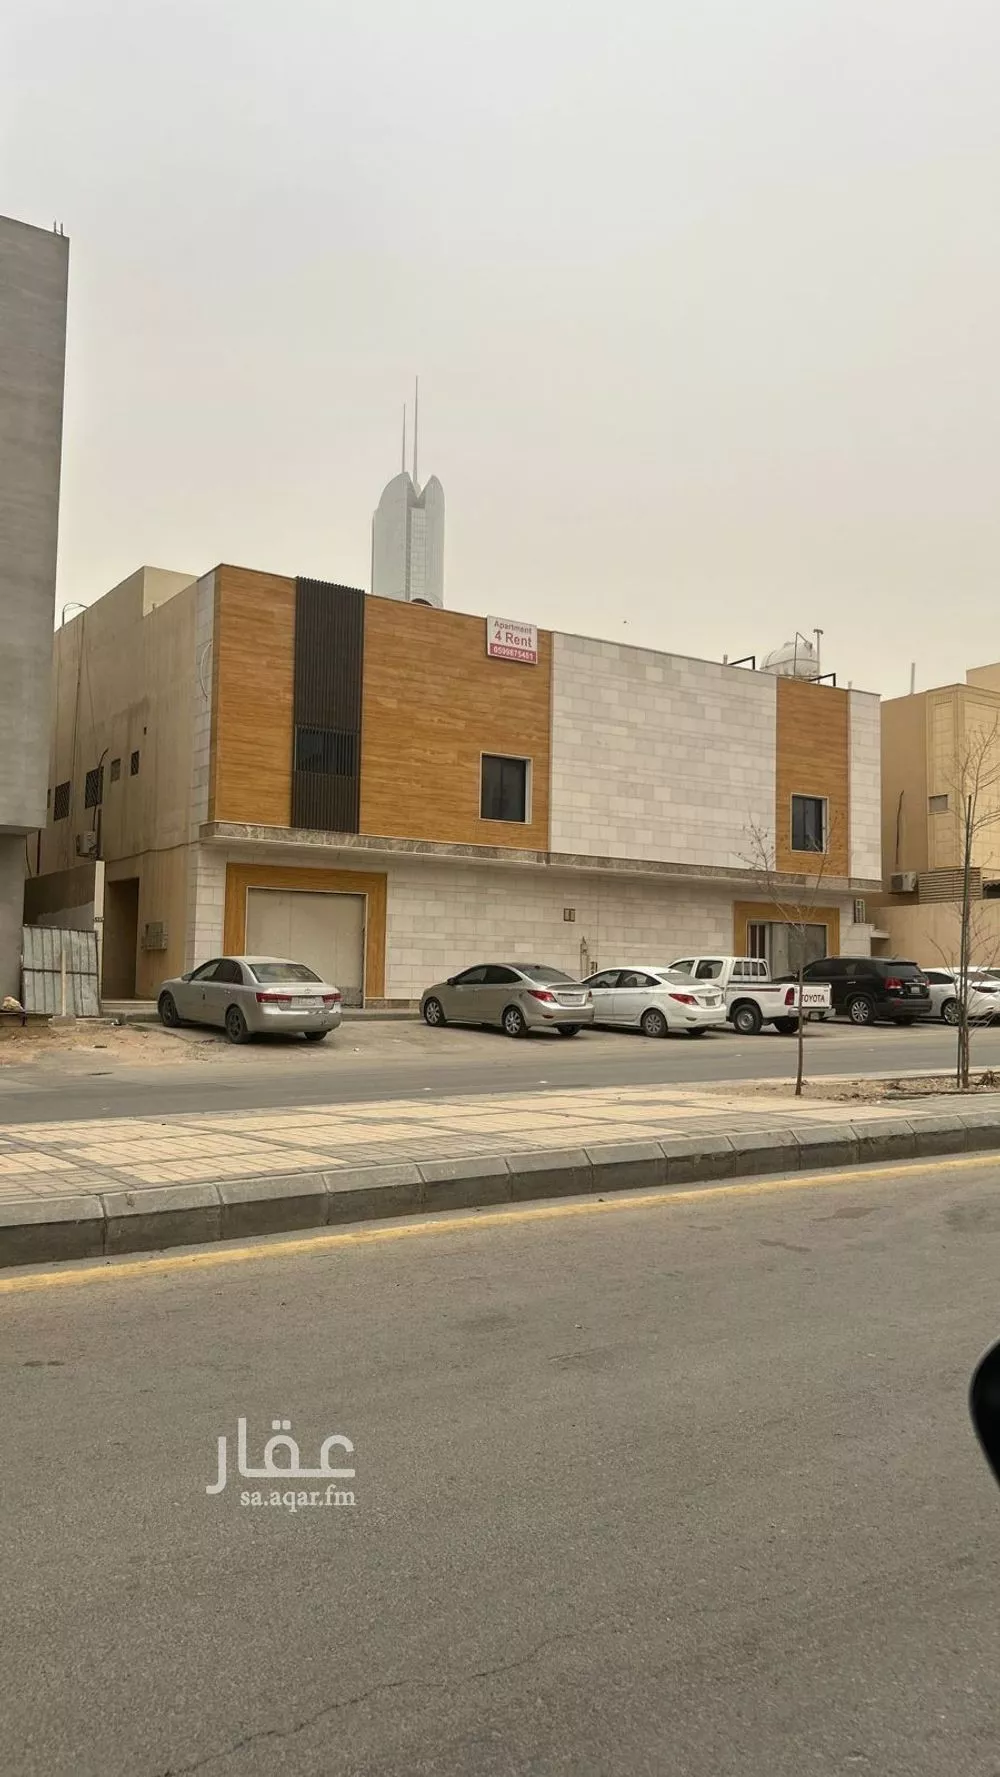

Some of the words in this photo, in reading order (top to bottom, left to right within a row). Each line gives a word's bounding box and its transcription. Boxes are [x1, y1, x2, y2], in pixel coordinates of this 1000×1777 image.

[494, 620, 532, 634] Apartment
[494, 630, 502, 641] 4
[505, 632, 532, 648] Rent
